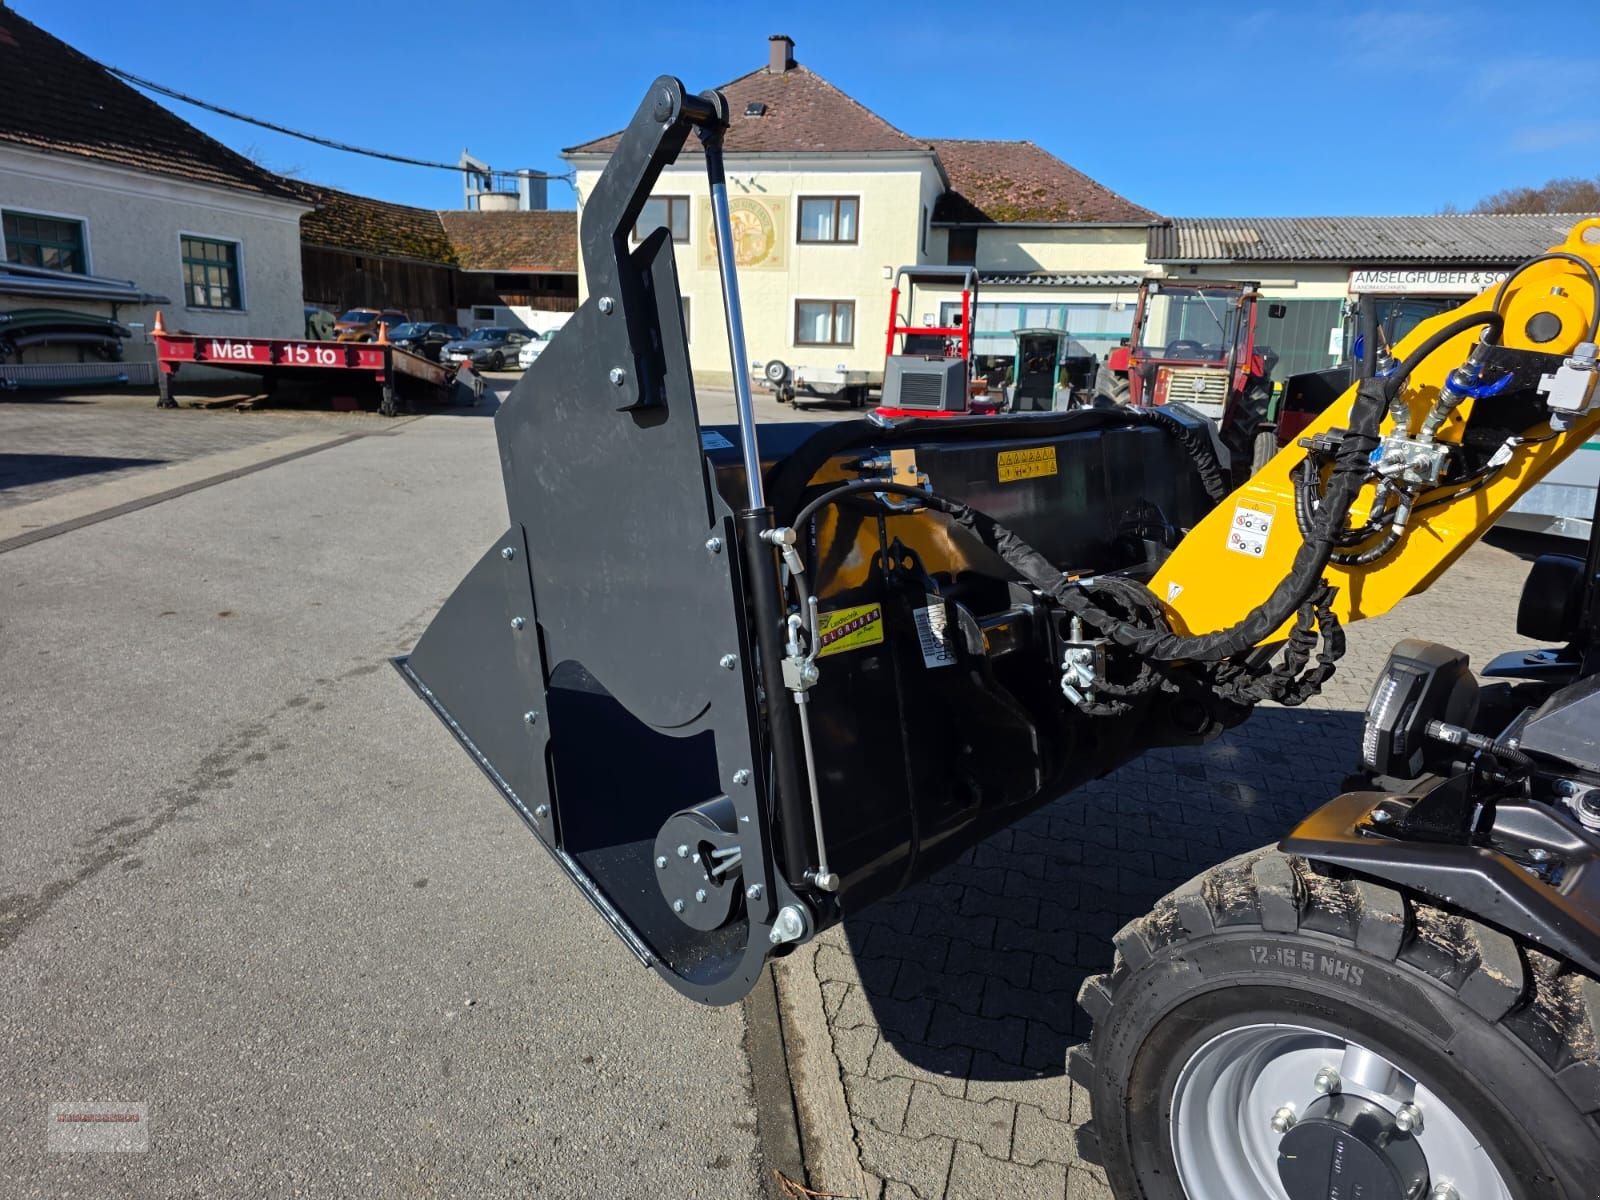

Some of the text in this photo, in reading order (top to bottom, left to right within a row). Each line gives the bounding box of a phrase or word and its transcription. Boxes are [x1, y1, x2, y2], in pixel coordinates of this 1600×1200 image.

[1355, 271, 1467, 284] AMSELGRUBER
[1470, 271, 1481, 284] &
[211, 339, 337, 365] Mat 15 to
[822, 610, 880, 643] ELGRUBER
[1320, 955, 1365, 986] NHS
